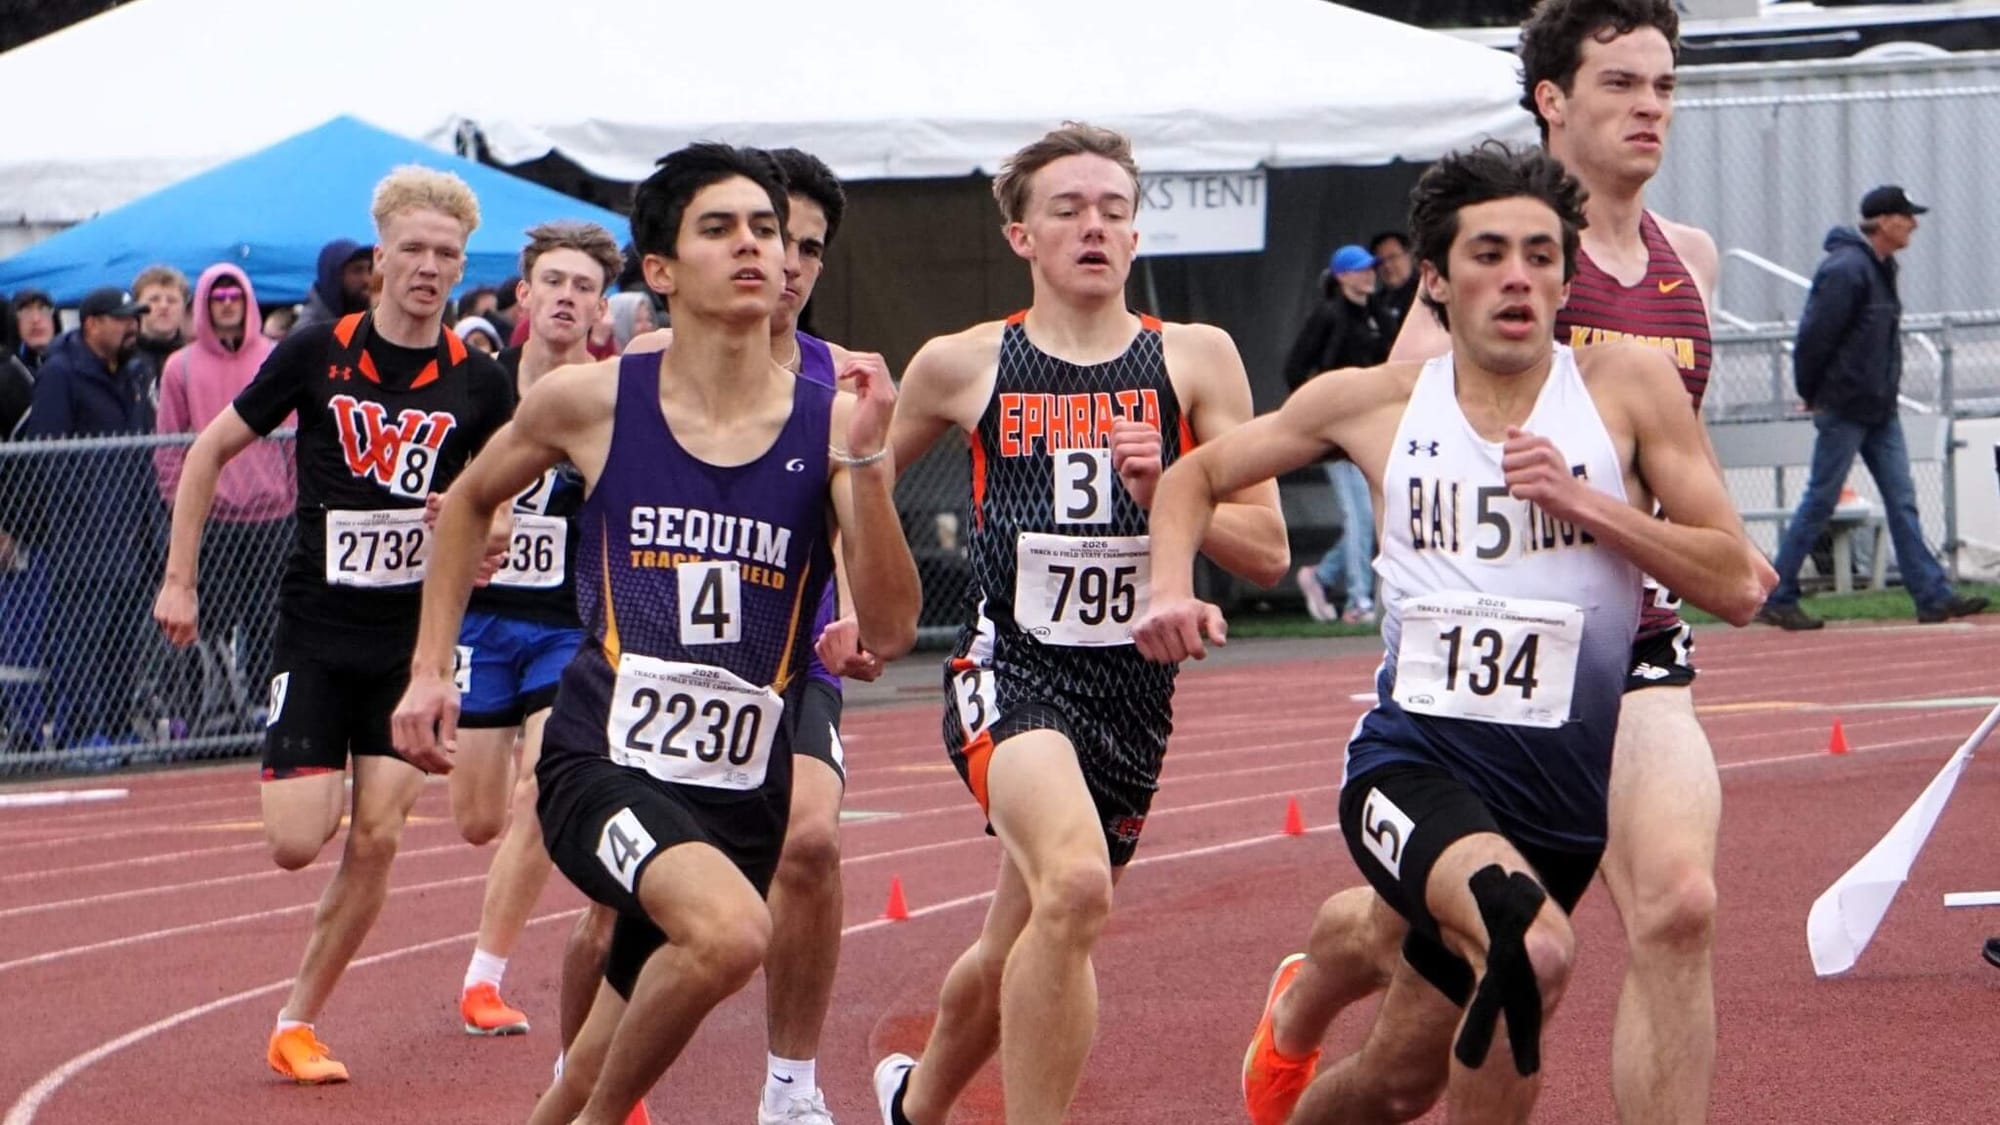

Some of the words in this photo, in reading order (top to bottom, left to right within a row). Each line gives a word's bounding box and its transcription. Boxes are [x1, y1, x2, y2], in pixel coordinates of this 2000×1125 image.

[1140, 177, 1174, 210] KS
[1184, 175, 1262, 209] TENT
[400, 447, 428, 493] 8
[1067, 452, 1098, 519] 3
[630, 506, 792, 569] SEQUIM
[1082, 541, 1108, 549] 2026
[1476, 486, 1511, 559] 5
[338, 528, 424, 571] 2732
[500, 534, 553, 572] 36
[691, 567, 731, 639] 4
[741, 564, 786, 590] IELD
[1048, 564, 1136, 625] 795
[1477, 597, 1507, 608] 2026
[1417, 604, 1441, 613] TRACK
[1475, 610, 1499, 619] STATE
[692, 668, 720, 679] 2026
[1439, 625, 1539, 699] 134
[625, 687, 762, 766] 2230
[961, 670, 985, 732] 3
[607, 821, 641, 874] 4
[1365, 802, 1400, 864] 5
